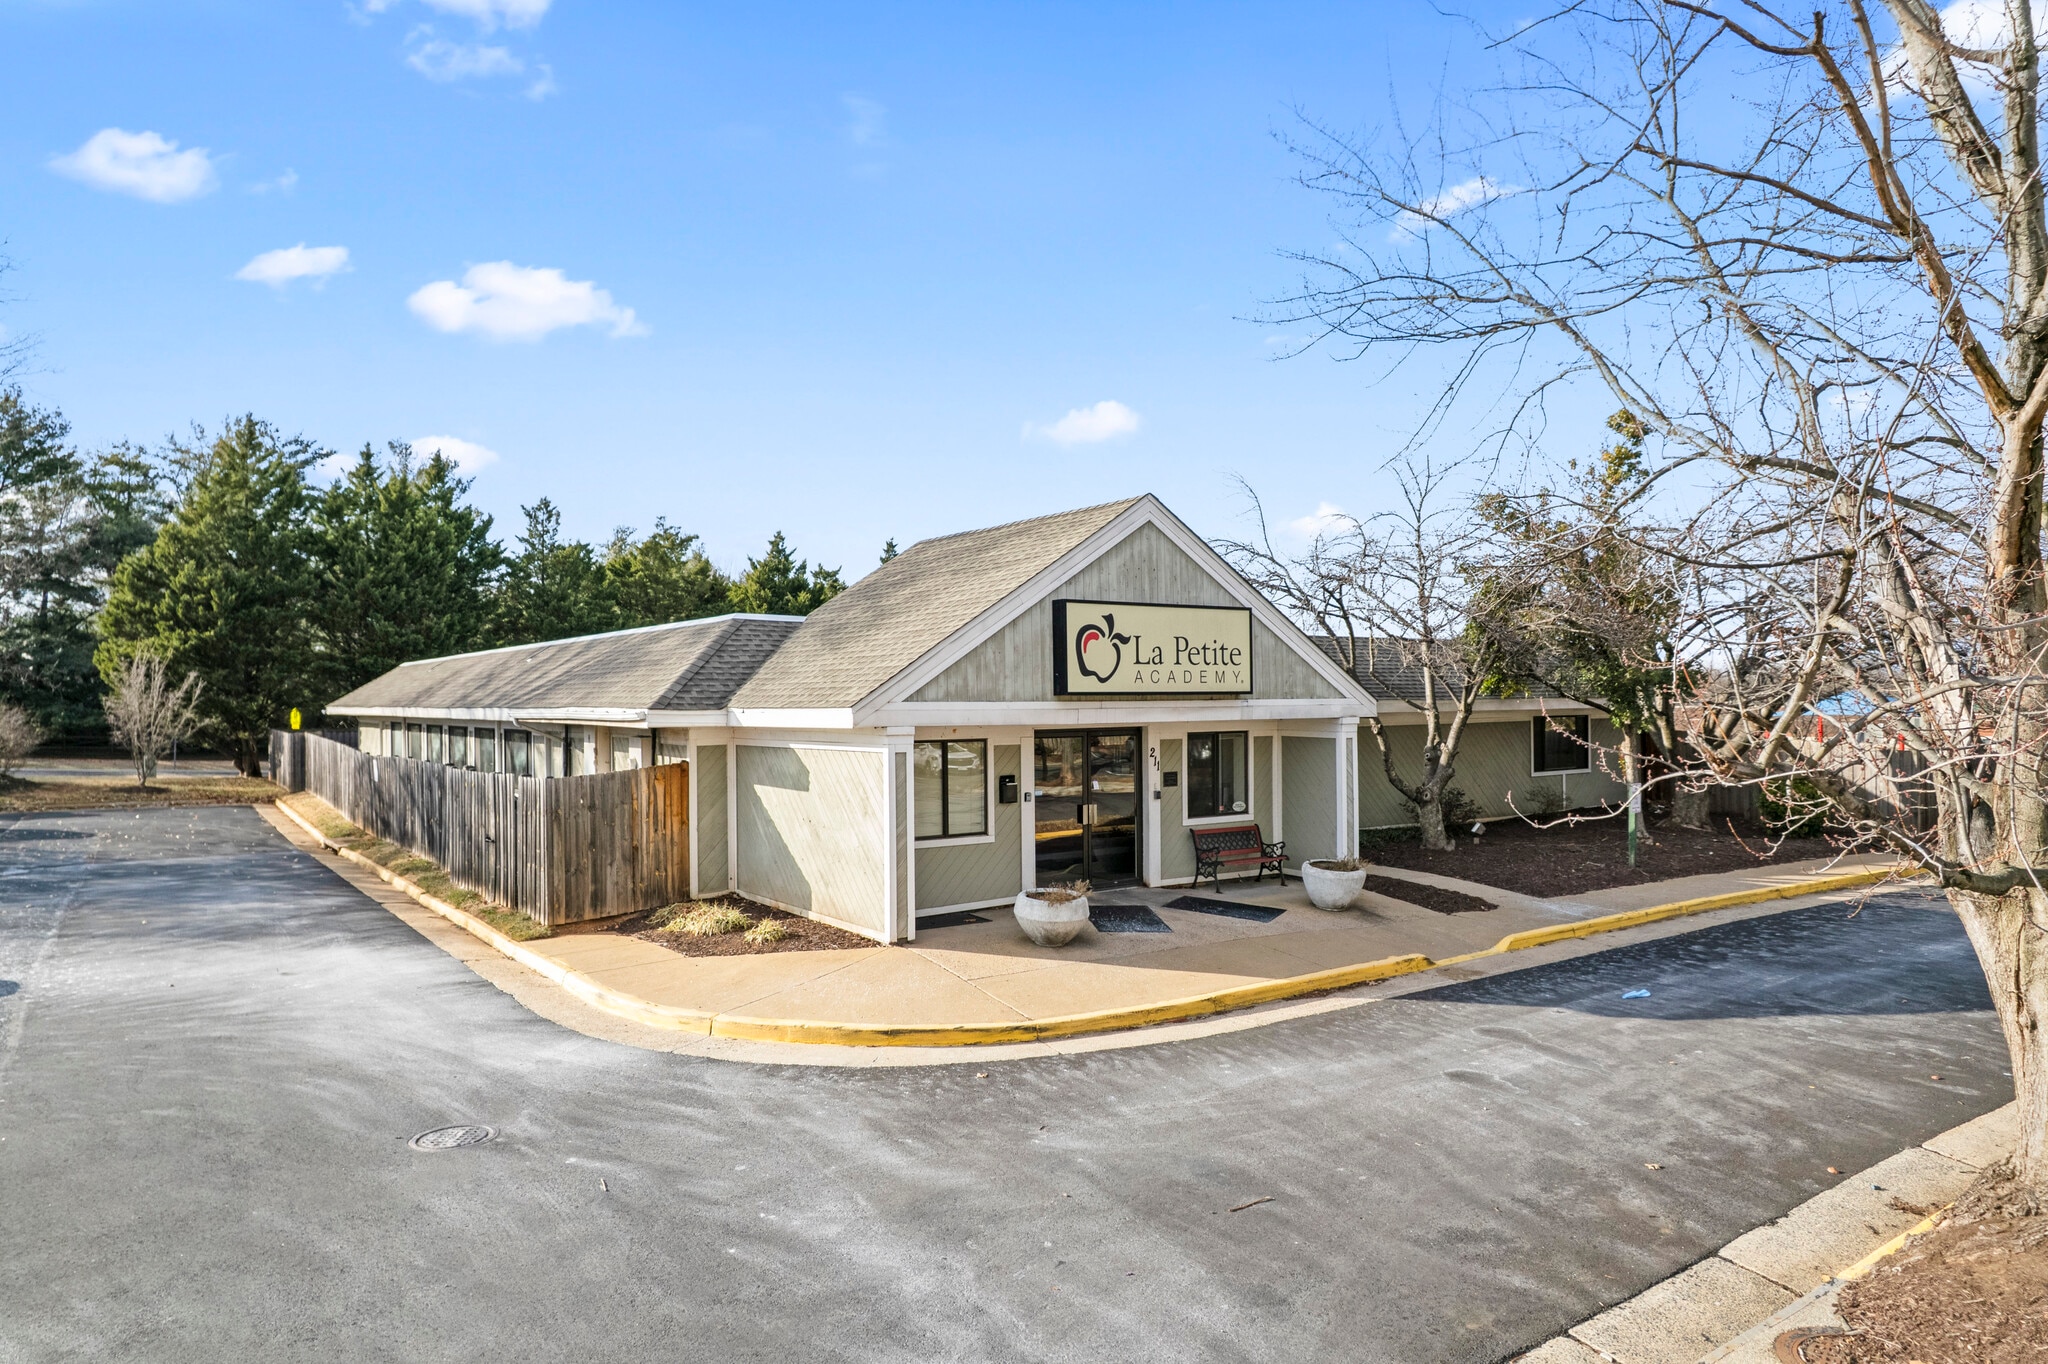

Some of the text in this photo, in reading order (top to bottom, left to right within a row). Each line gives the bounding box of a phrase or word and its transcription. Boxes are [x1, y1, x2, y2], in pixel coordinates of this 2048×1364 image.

[1133, 635, 1242, 666] La Petite
[1149, 747, 1160, 771] 211
